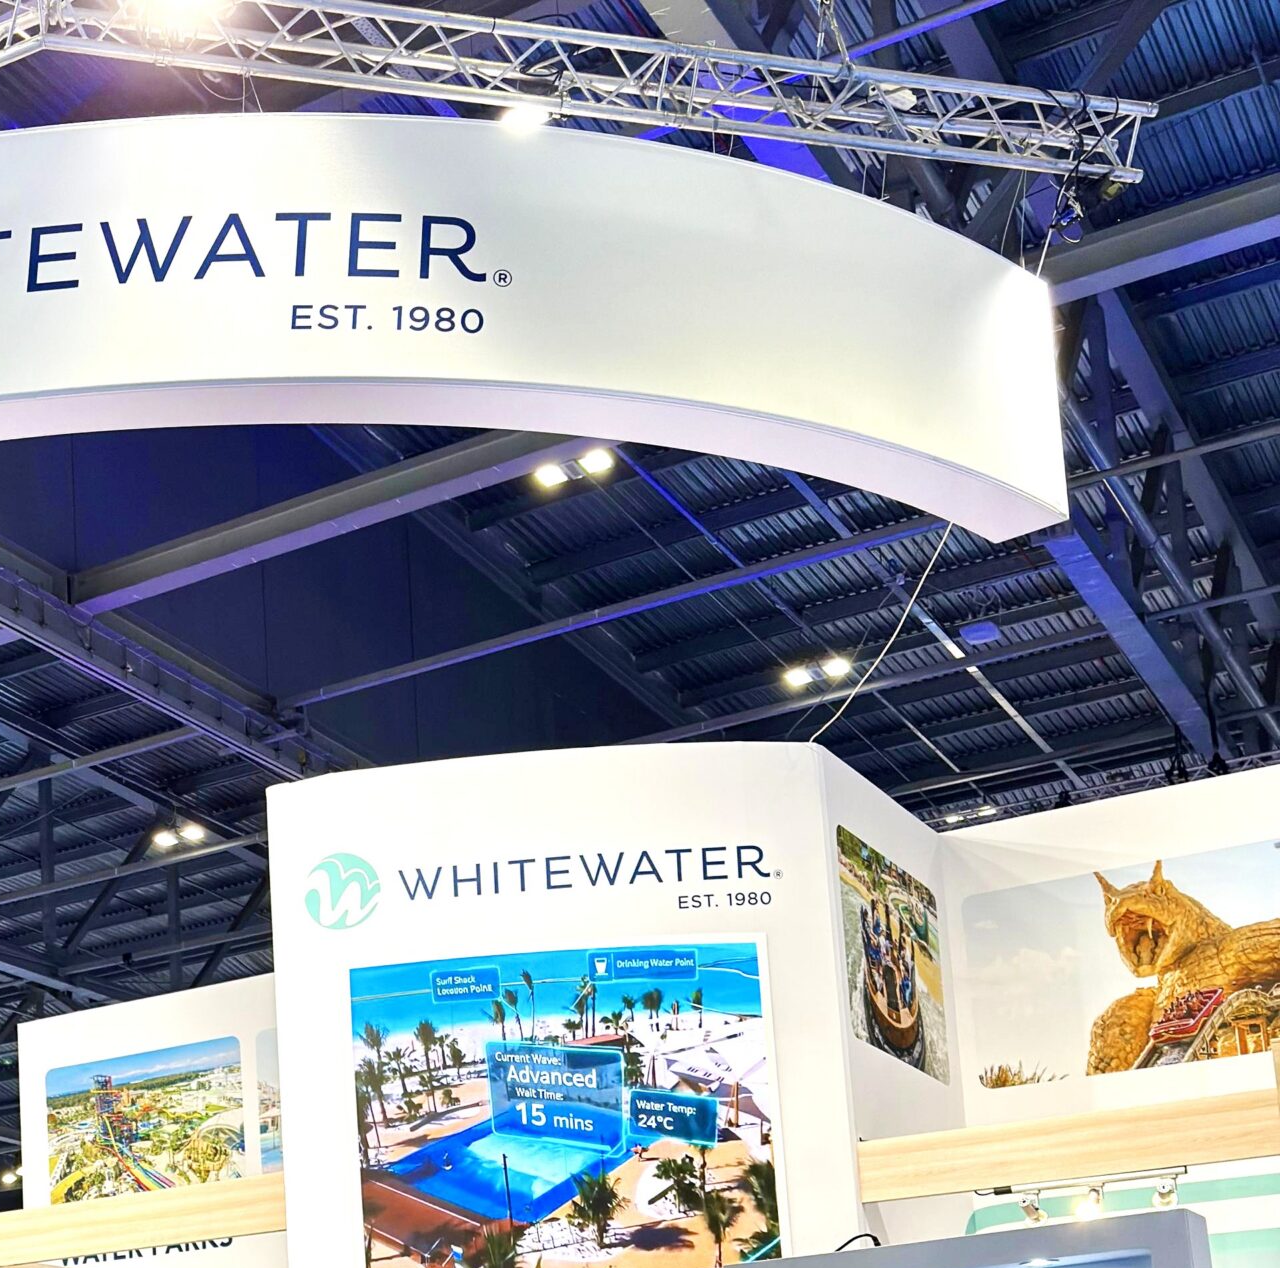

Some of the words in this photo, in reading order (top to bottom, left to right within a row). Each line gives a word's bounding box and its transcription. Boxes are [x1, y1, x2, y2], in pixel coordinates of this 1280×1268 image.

[290, 304, 373, 330] EST.
[392, 305, 485, 334] 1980
[678, 893, 720, 910] EST.
[727, 890, 772, 907] 1980
[616, 958, 649, 970] Drinking
[650, 958, 674, 968] Water
[675, 957, 695, 967] Point
[495, 1051, 530, 1064] Current
[533, 1055, 562, 1067] Wave:
[507, 1065, 597, 1089] Advanced
[515, 1086, 537, 1099] Wait
[538, 1088, 564, 1101] Time:
[636, 1099, 665, 1112] Water
[667, 1101, 697, 1116] Temp:
[516, 1102, 547, 1127] 15
[553, 1113, 594, 1132] mins
